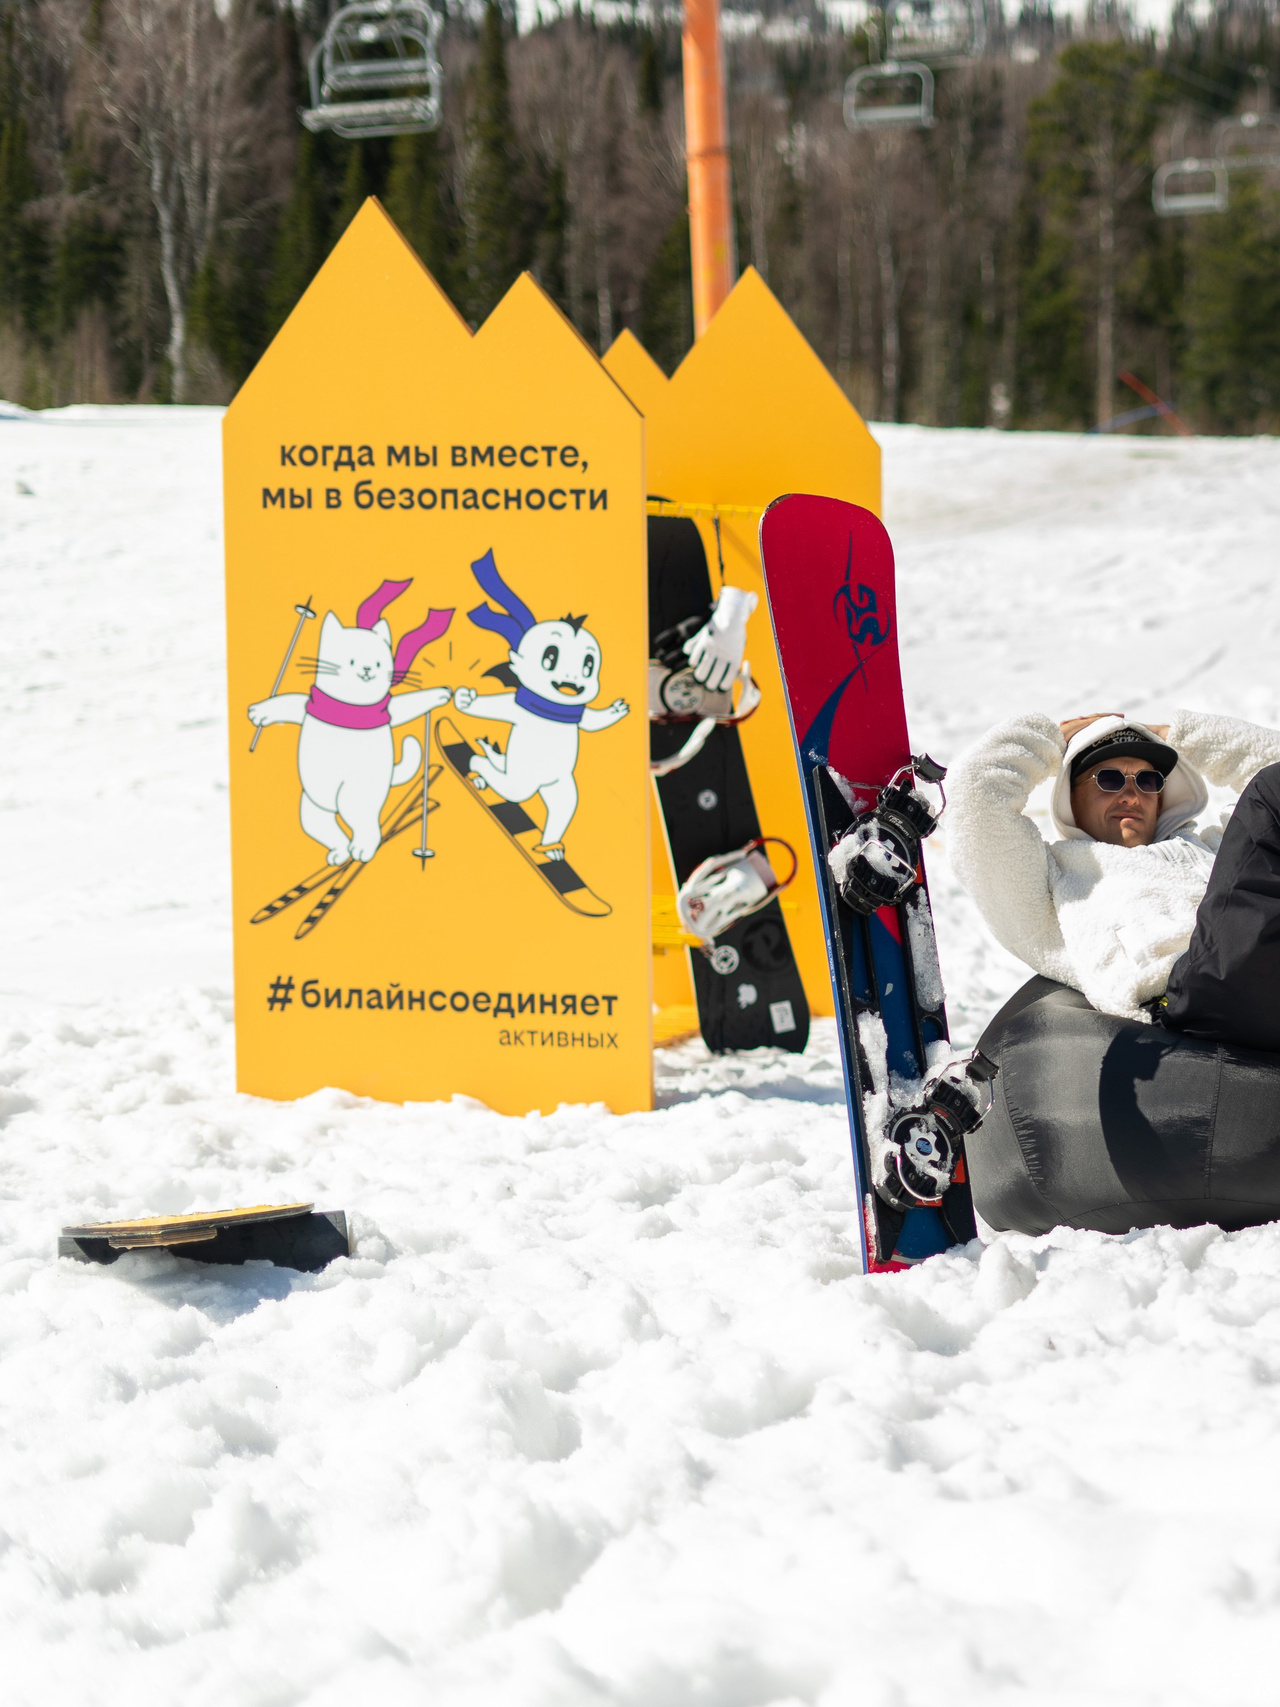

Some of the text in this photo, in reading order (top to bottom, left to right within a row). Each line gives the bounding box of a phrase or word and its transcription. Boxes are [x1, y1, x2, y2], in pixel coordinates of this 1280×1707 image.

[280, 444, 589, 473] когда мы вместе,
[262, 479, 608, 511] мы в безопасности
[266, 975, 619, 1019] #билайнсоединяет
[498, 1029, 619, 1049] активных
